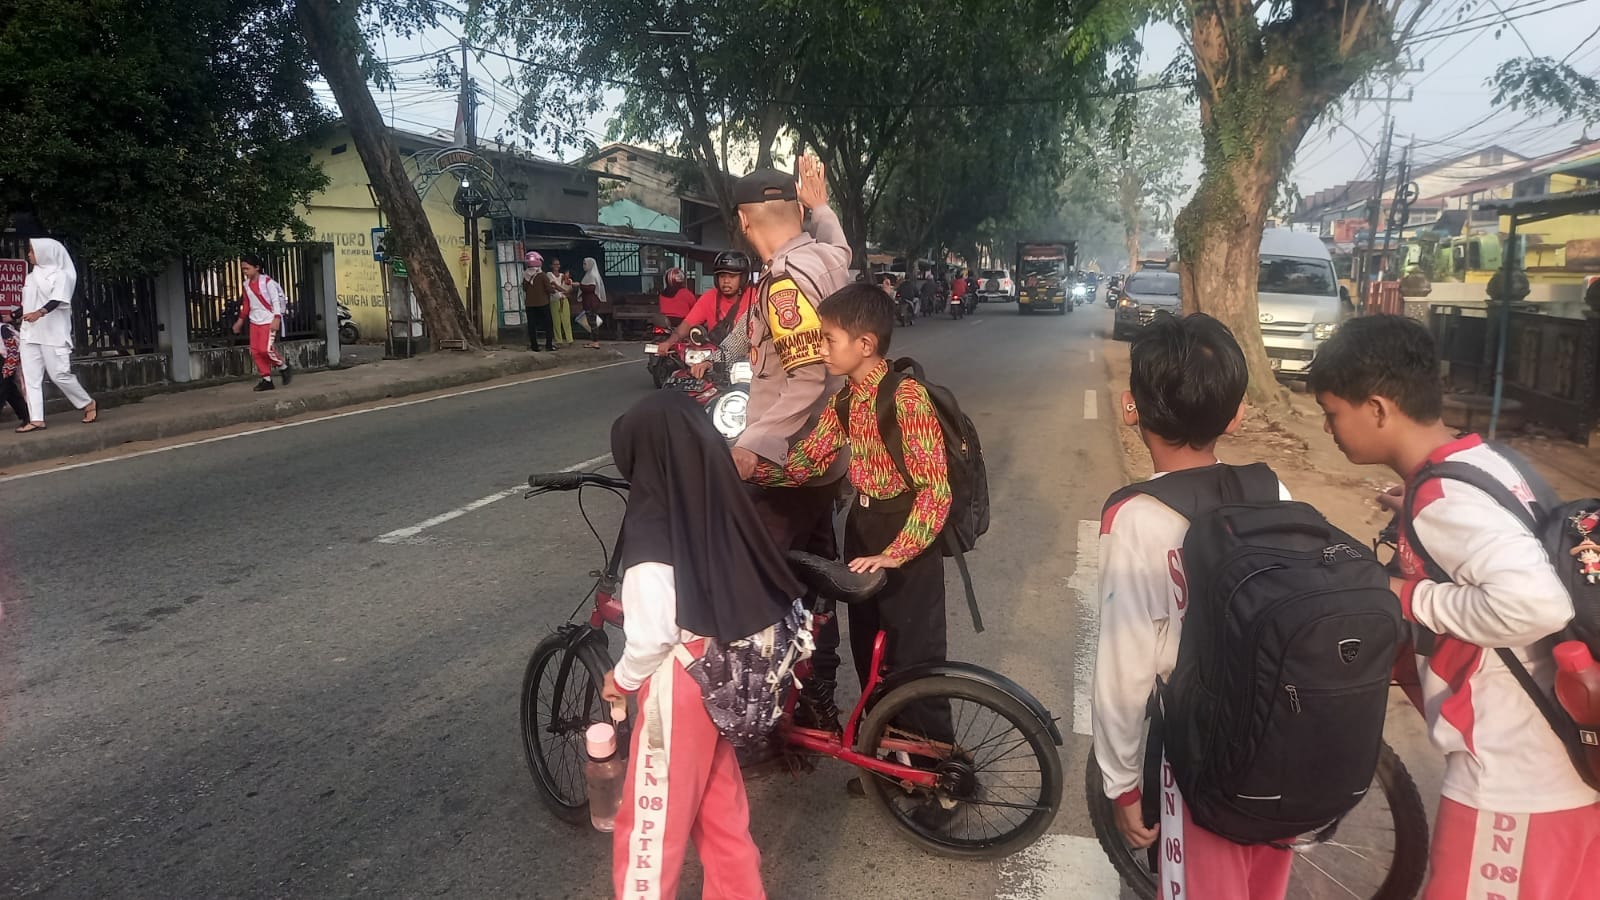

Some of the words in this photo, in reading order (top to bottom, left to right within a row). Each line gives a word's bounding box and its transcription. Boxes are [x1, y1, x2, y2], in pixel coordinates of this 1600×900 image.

[337, 294, 373, 307] SUNGAI
[638, 795, 663, 811] 08
[635, 820, 655, 869] PTK
[1165, 837, 1182, 864] 08
[1480, 862, 1518, 884] 08
